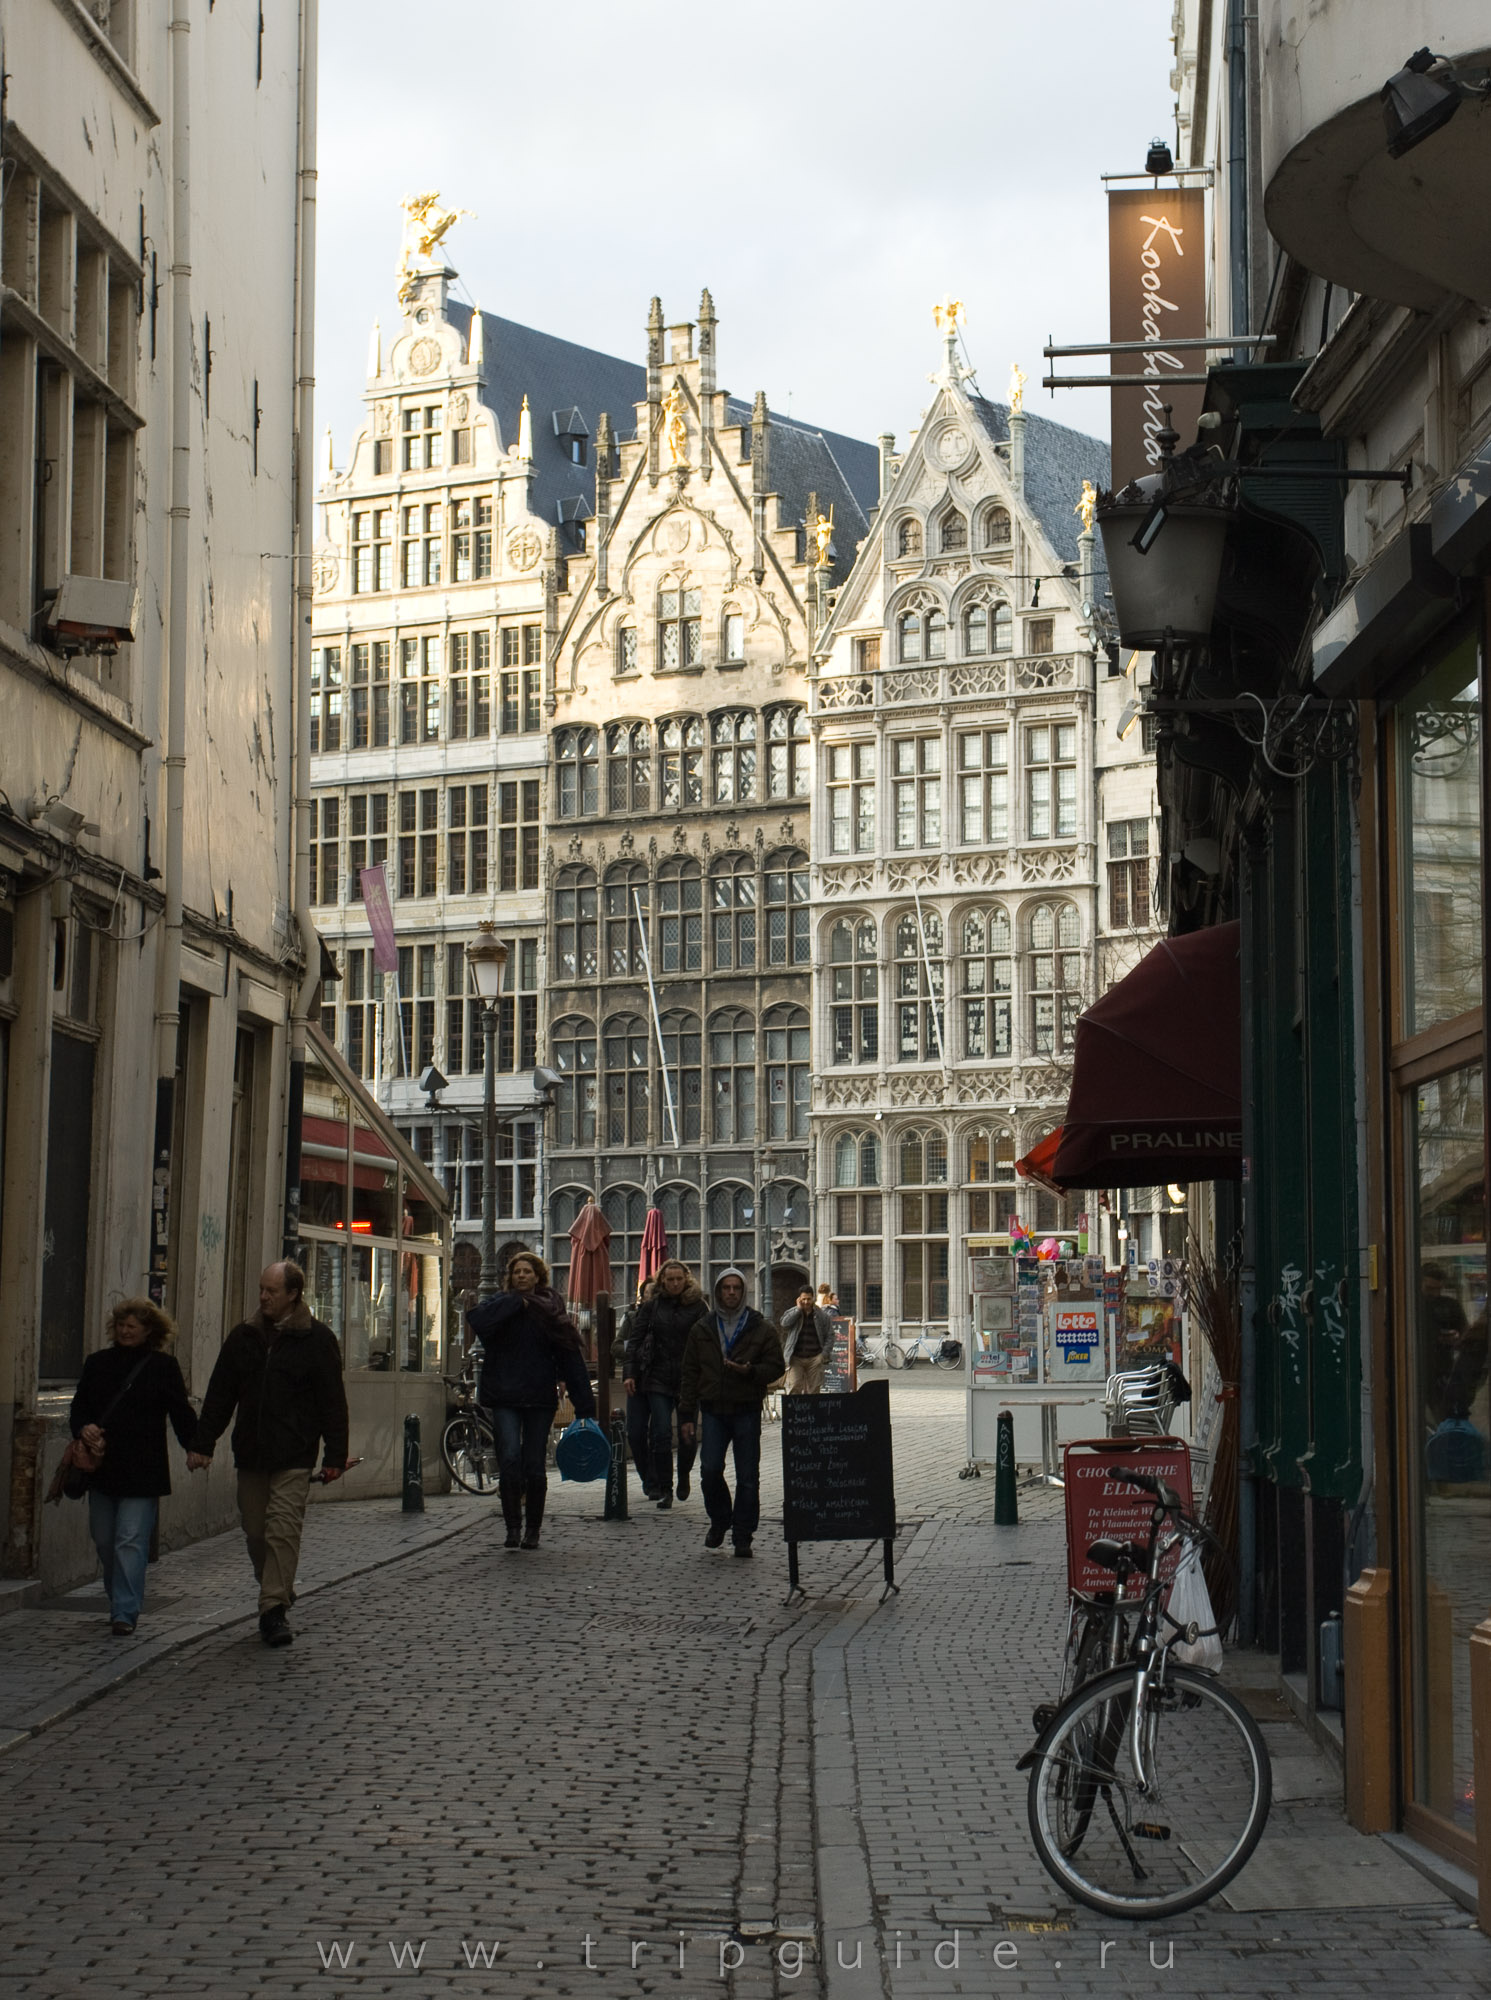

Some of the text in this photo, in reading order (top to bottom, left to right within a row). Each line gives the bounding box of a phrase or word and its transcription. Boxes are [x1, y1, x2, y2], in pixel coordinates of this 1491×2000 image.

[999, 1423, 1011, 1471] AMOK
[1102, 1482, 1146, 1496] ELIS
[1088, 1509, 1101, 1517] De
[1103, 1507, 1139, 1517] Kleinste
[1088, 1519, 1099, 1529] In
[1102, 1517, 1153, 1528] Vlaanderen
[1085, 1531, 1098, 1541] De
